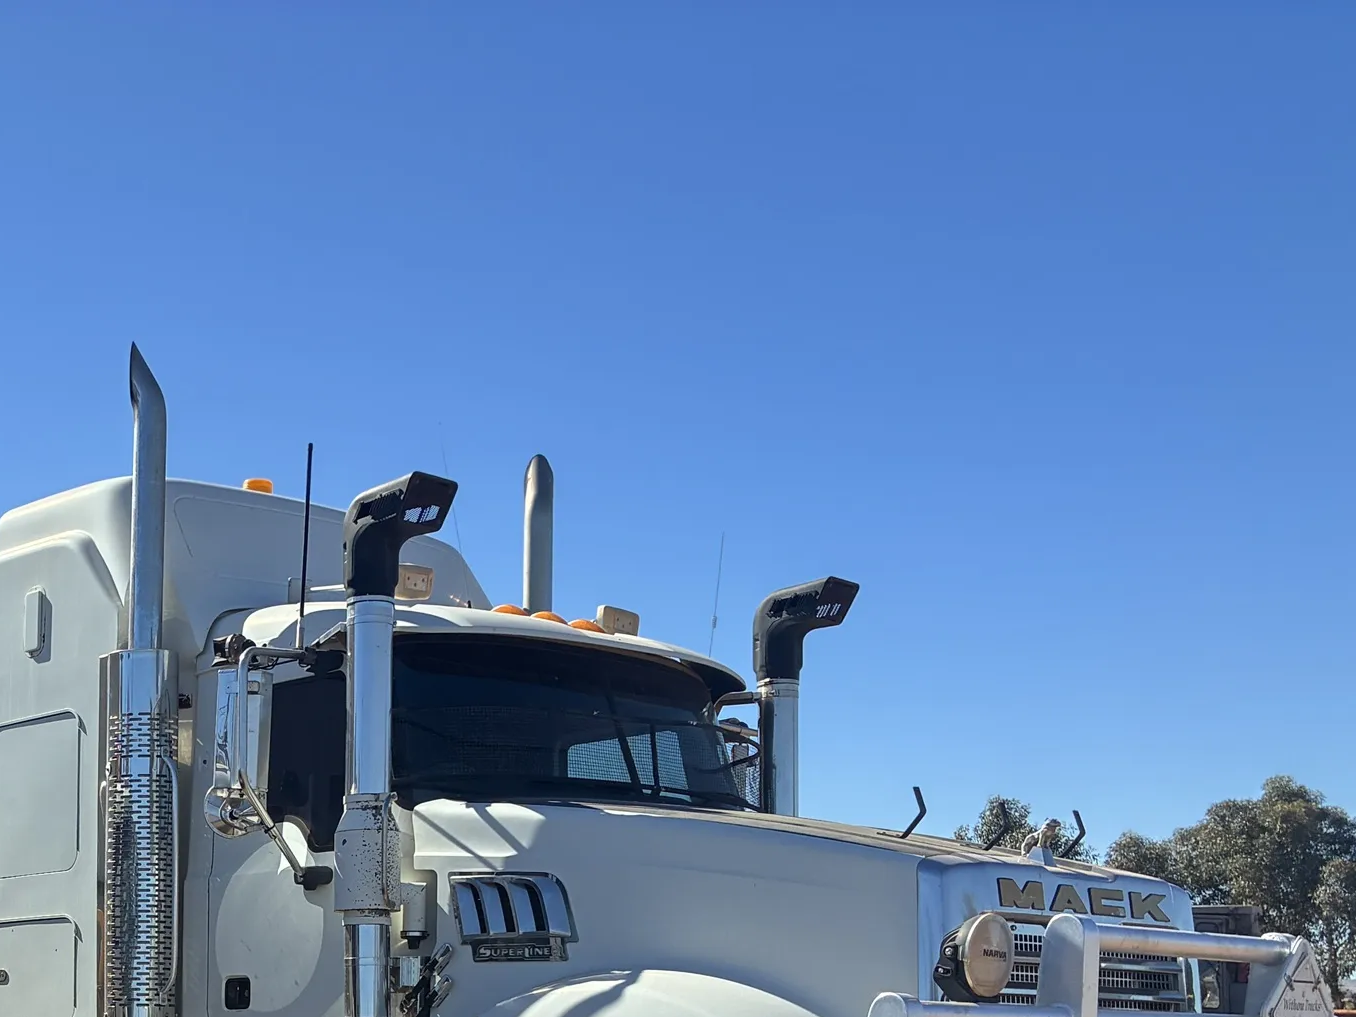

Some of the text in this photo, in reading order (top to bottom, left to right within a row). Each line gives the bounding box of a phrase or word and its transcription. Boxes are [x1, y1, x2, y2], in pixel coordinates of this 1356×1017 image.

[997, 878, 1171, 922] MACK
[982, 949, 1007, 959] NARVA
[1283, 998, 1305, 1011] Withou
